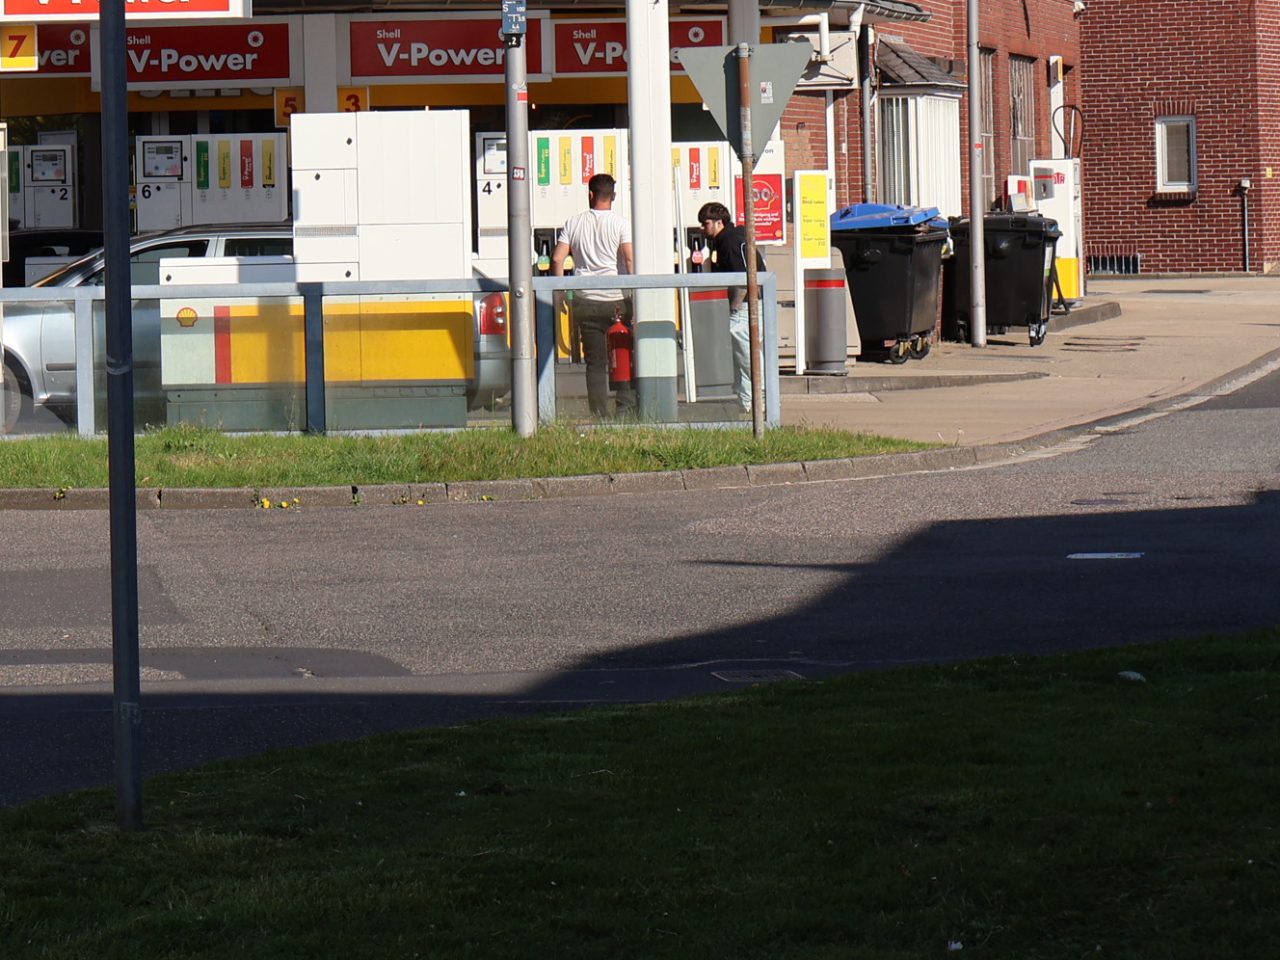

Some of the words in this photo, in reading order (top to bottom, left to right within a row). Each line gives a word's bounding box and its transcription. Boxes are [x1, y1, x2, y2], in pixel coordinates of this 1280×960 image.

[126, 35, 151, 45] Shell
[376, 29, 401, 39] Shell
[572, 29, 597, 39] Shell
[8, 35, 28, 58] 7
[128, 48, 258, 73] V-Power
[377, 42, 505, 67] V-Power
[284, 96, 297, 117] 5
[345, 93, 361, 112] 3
[59, 187, 69, 201] 2
[141, 184, 152, 199] 6
[482, 181, 493, 195] 4
